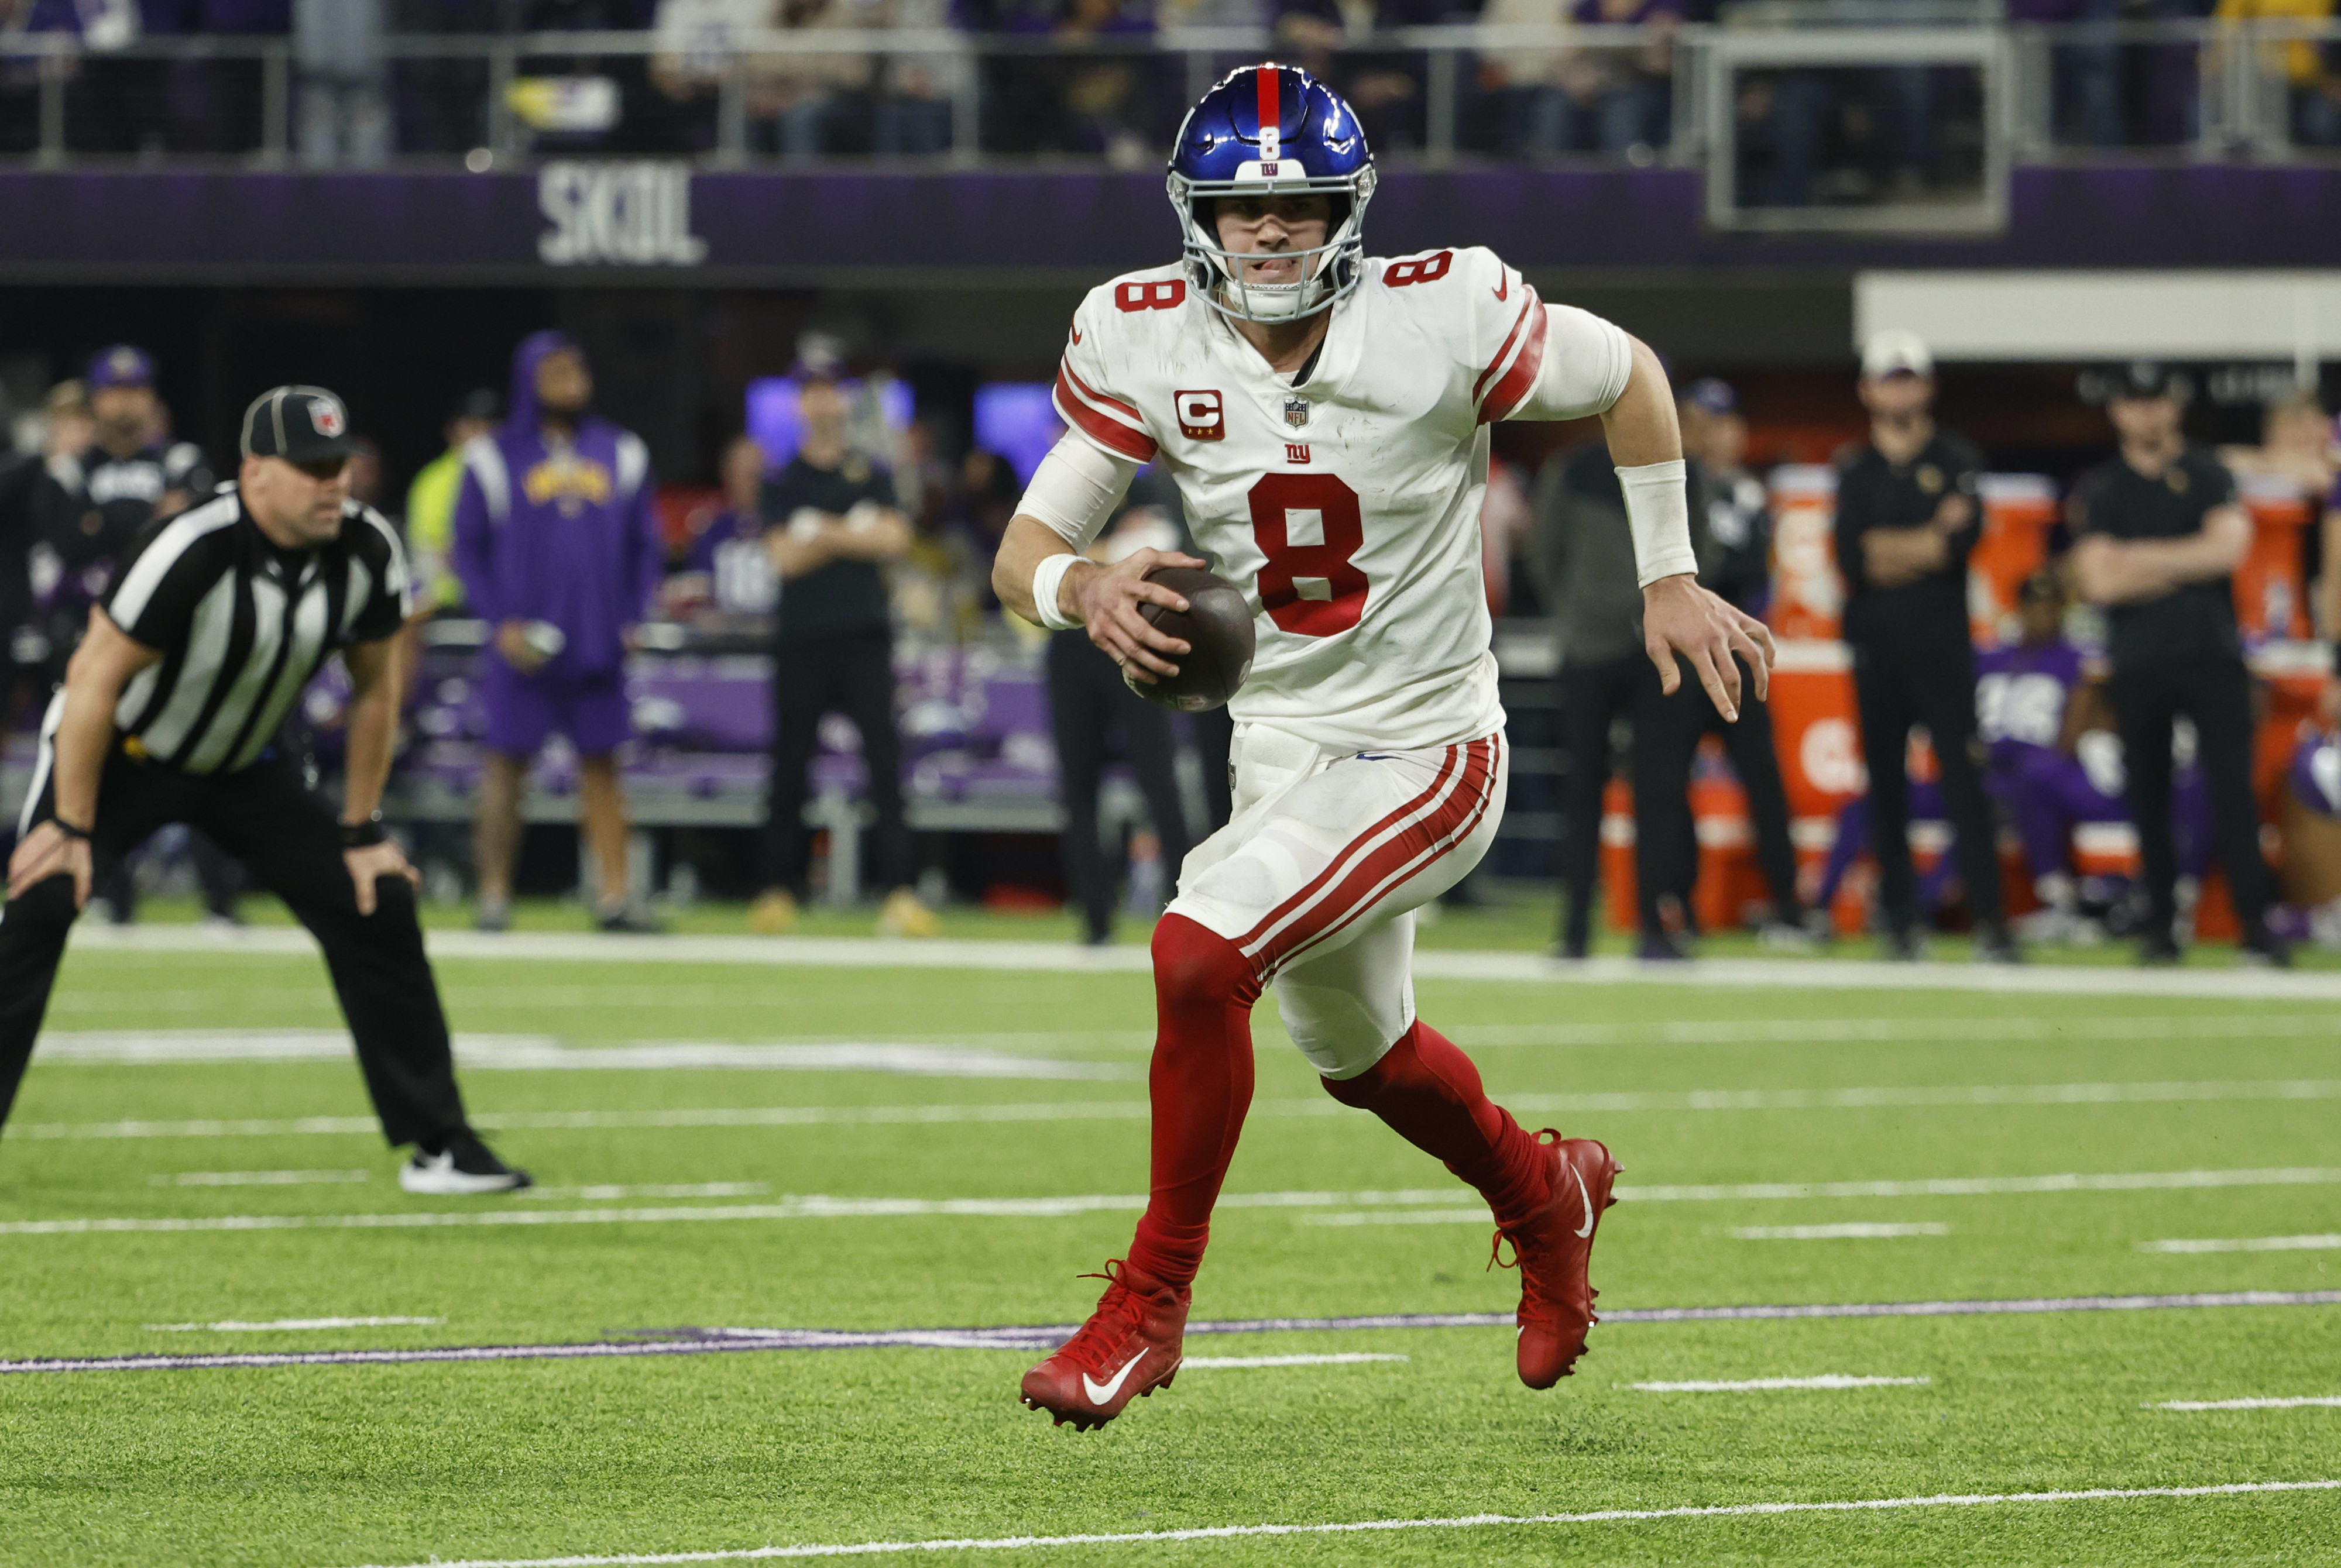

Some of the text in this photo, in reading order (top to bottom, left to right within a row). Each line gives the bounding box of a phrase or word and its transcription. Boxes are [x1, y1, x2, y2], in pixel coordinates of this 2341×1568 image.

[1259, 126, 1281, 160] 8
[536, 159, 709, 265] SKOL
[1382, 250, 1454, 288] 8
[1114, 278, 1186, 313] 8
[1178, 393, 1220, 427] C
[1287, 411, 1305, 425] NFL
[1247, 472, 1370, 638] 8
